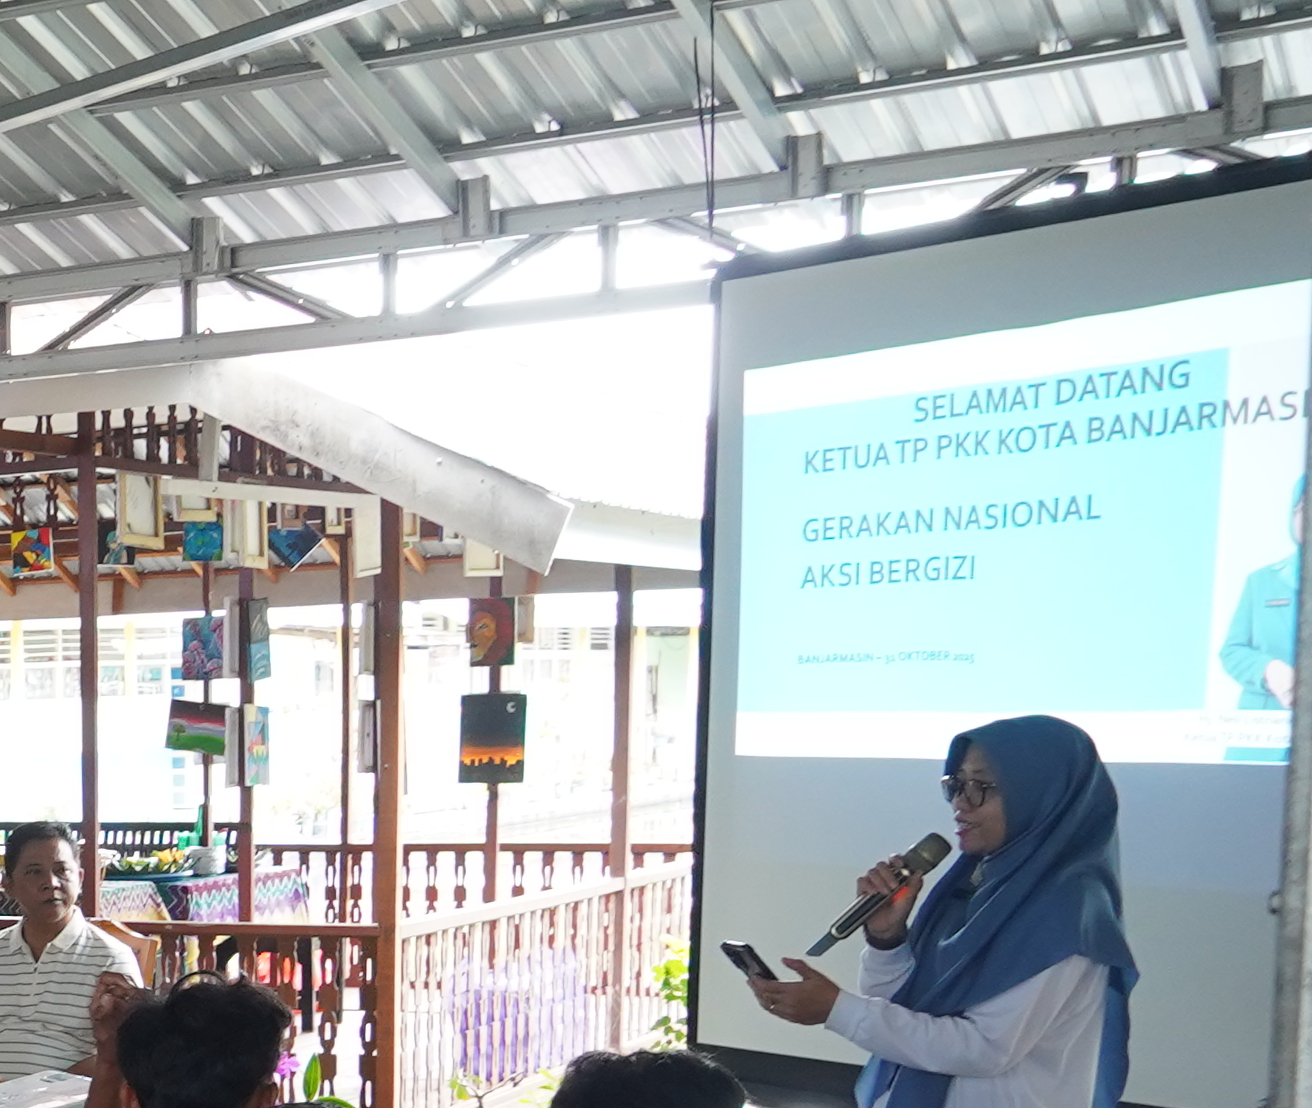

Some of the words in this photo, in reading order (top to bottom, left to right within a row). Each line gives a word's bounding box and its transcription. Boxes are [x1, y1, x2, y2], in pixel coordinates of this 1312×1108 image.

[912, 381, 1047, 423] SELAMAT
[1054, 358, 1193, 407] DATANG
[802, 442, 891, 476] KETUA
[895, 437, 929, 465] TP
[935, 429, 993, 461] PKK
[996, 420, 1078, 455] KOTA
[801, 507, 935, 544] GERAKAN
[942, 493, 1103, 534] NASIONAL
[798, 561, 862, 590] AKSI
[869, 555, 976, 586] BERGIZI
[797, 653, 874, 665] BANJARMASIN
[898, 651, 951, 662] OKTOBER
